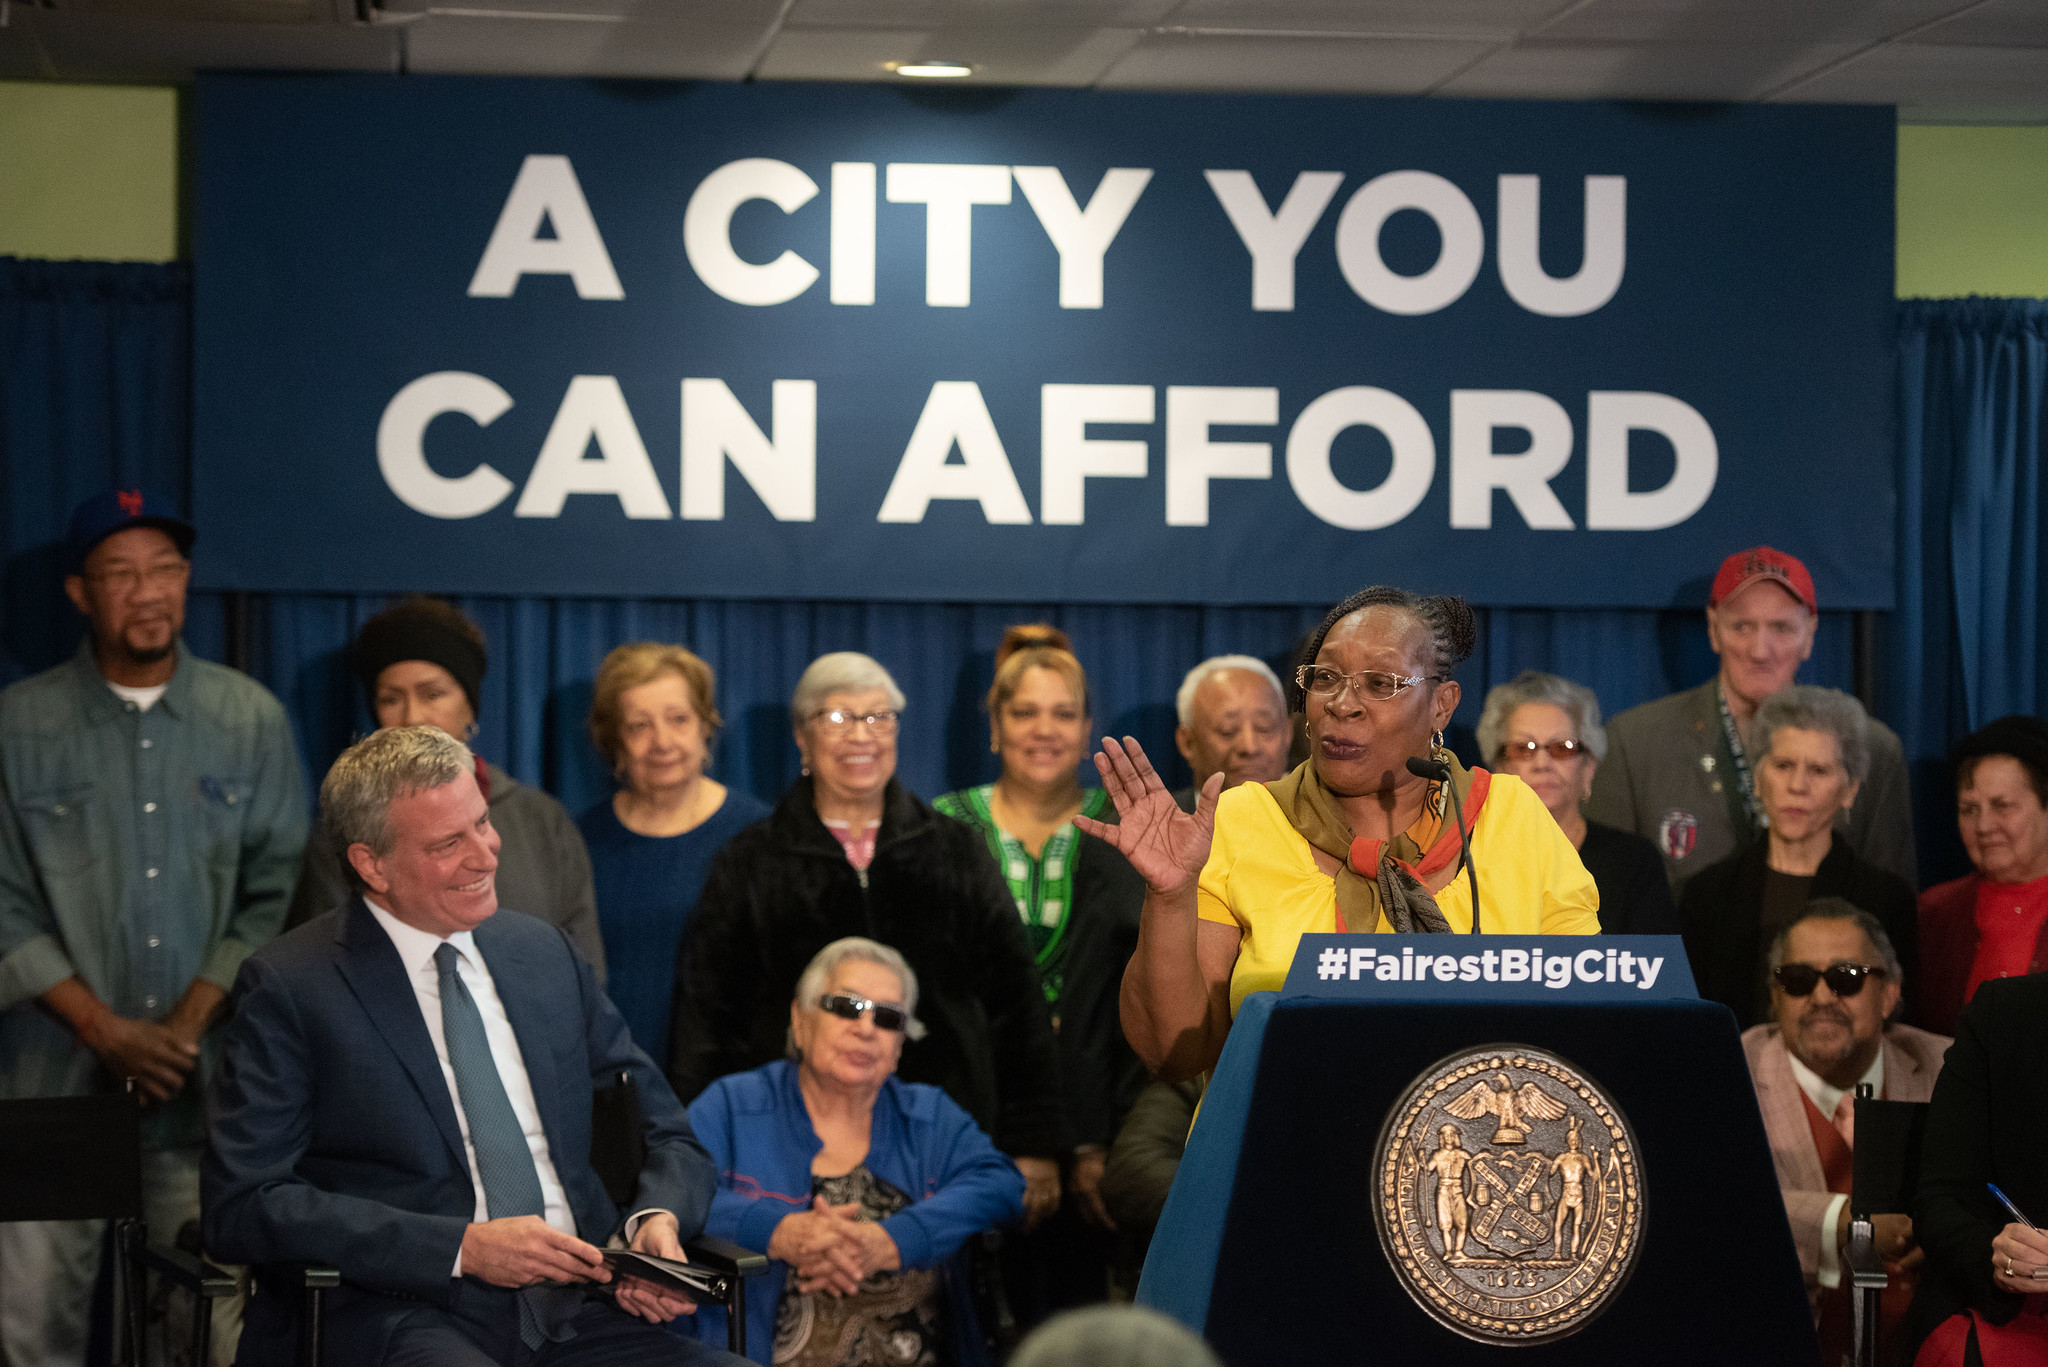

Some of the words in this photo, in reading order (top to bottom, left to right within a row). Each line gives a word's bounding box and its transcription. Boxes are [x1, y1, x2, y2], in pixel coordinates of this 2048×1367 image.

[468, 155, 625, 301] A
[683, 157, 1153, 311] CITY
[1205, 169, 1627, 317] YOU
[377, 371, 819, 523] CAN
[876, 379, 1719, 532] AFFORD
[1316, 946, 1665, 990] #FairestBigCity
[1434, 1269, 1525, 1316] CIVITATIS
[1536, 1277, 1584, 1311] NOVI
[1584, 1193, 1621, 1276] EBORACI
[1487, 1270, 1539, 1288] 1625
